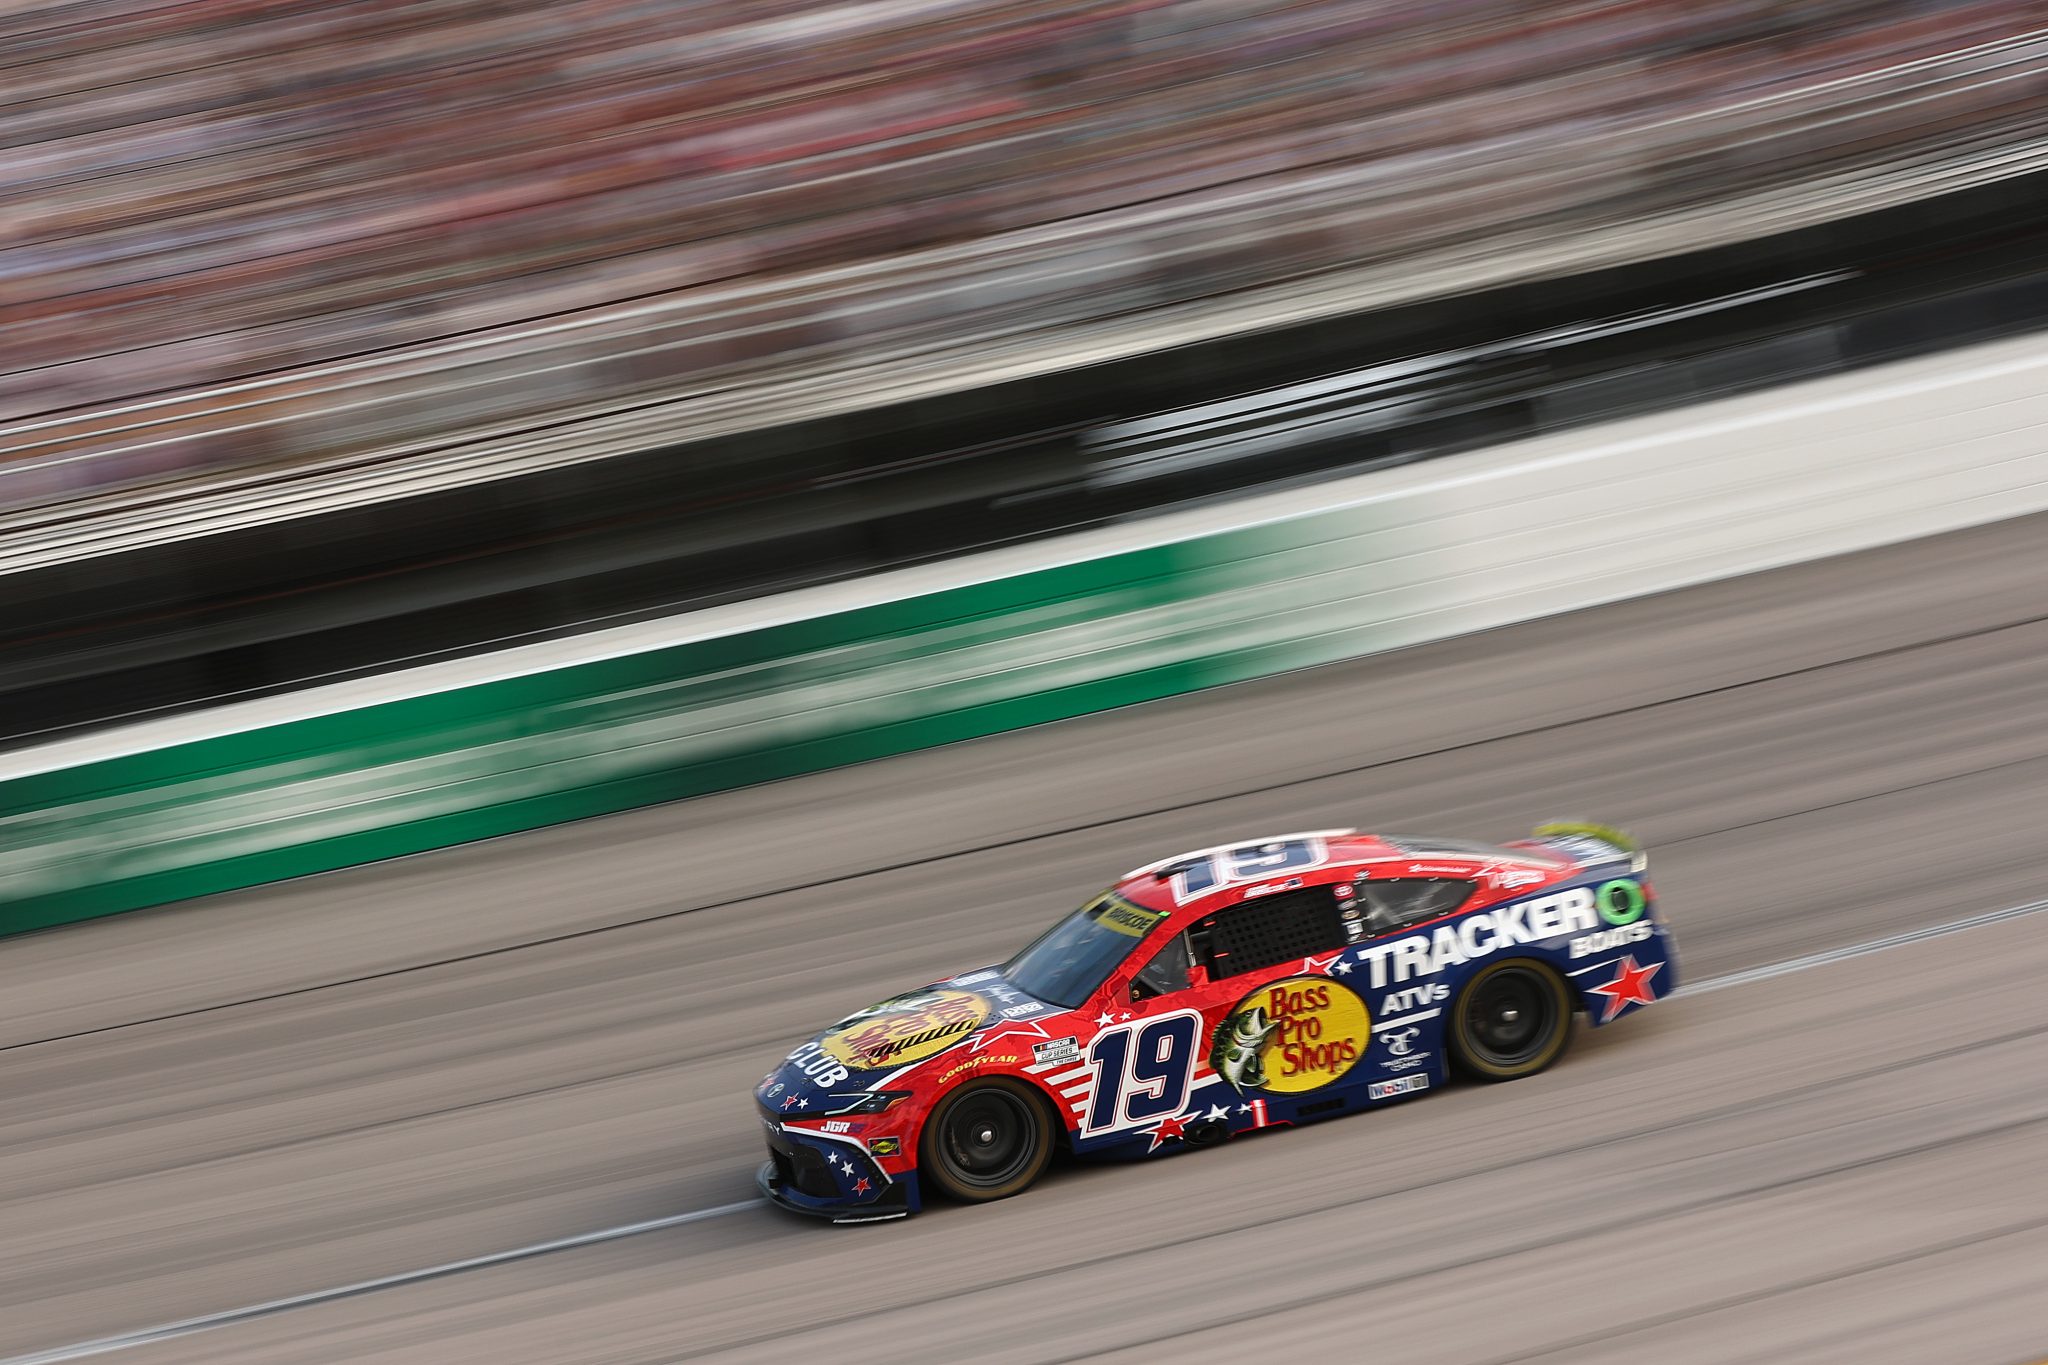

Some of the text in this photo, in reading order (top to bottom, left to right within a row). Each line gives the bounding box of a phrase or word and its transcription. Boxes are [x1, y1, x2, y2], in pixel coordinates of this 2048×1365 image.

[1357, 887, 1599, 989] TRACKER
[1568, 919, 1654, 960] BOATS
[1269, 985, 1330, 1020] Bass
[1379, 982, 1451, 1016] ATVs
[1046, 1038, 1071, 1049] NASCAR
[1277, 1016, 1322, 1046] Pro
[786, 1041, 849, 1088] CLUB
[937, 1055, 1019, 1084] GOODYEAR
[1041, 1047, 1073, 1060] CUP SERIES
[1281, 1038, 1358, 1077] Shops
[1084, 1013, 1200, 1135] 19
[820, 1120, 851, 1133] JGR
